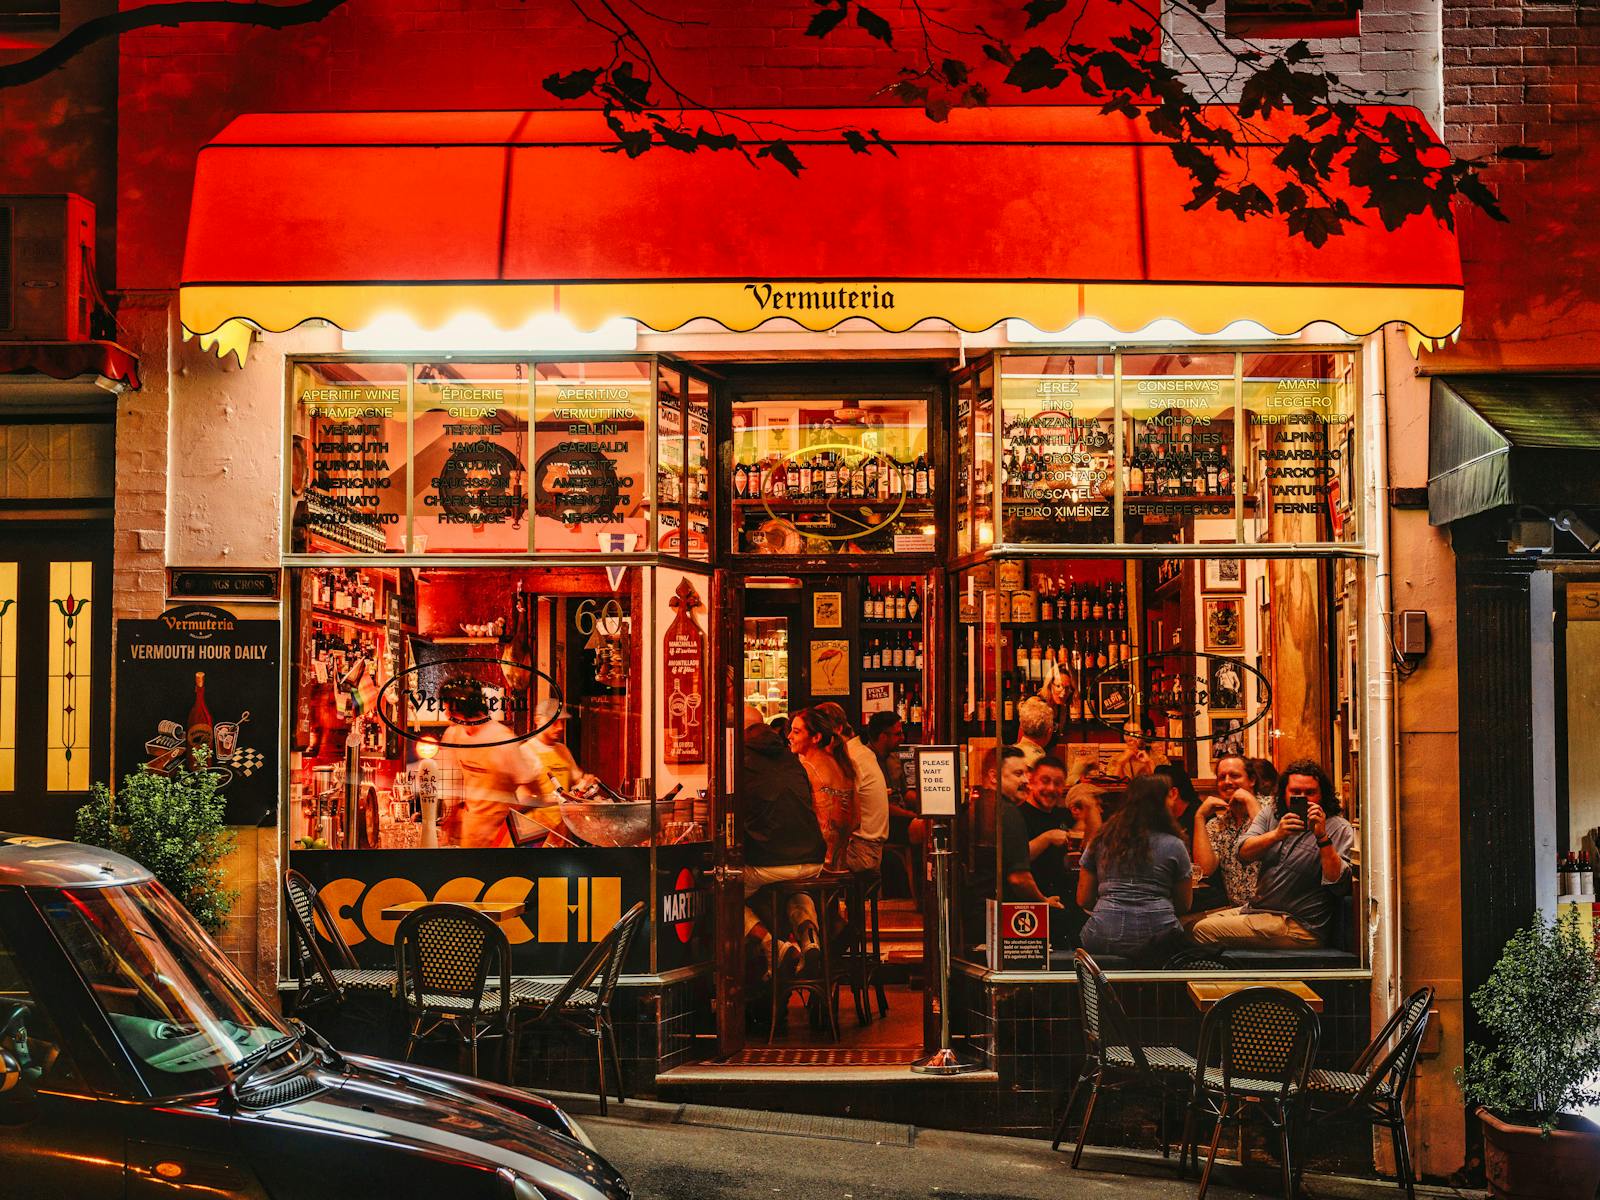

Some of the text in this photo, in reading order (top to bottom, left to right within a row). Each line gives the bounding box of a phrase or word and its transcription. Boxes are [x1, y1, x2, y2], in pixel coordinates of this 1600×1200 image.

[744, 284, 894, 310] Vermuteria
[1037, 382, 1078, 393] JEREZ
[1137, 381, 1219, 391] CONSERVAS
[1278, 380, 1319, 390] AMARI
[302, 390, 400, 400] APERITIF WINE
[442, 386, 503, 400] ÉPICERIE
[558, 389, 629, 400] APERITIVO
[1042, 400, 1074, 410] FINO
[1150, 399, 1208, 409] SARDINA
[1266, 397, 1332, 407] LEGGERO
[309, 407, 393, 418] CHAMPAGNE
[448, 408, 497, 418] GILDAS
[554, 408, 635, 419] VERMUTTINO
[1016, 418, 1100, 428] MANZANILLA
[1146, 416, 1211, 426] ANCHOAS
[1250, 415, 1348, 425] MEDITERRANEO
[322, 425, 380, 436] VERMUT
[443, 425, 501, 435] TERRINE
[569, 425, 618, 435] BELLINI
[1010, 436, 1104, 446] AMONTILLADO
[1138, 434, 1220, 444] MEJILLONES
[1275, 432, 1323, 442] ALPINO
[312, 442, 388, 453] VERMOUTH
[448, 440, 496, 453] JAMÓN
[558, 442, 628, 453] GARIBALDI
[1026, 453, 1091, 464] OLOROSO
[1138, 452, 1219, 462] CALAMARES
[1259, 450, 1341, 460] RABARBARO
[313, 460, 389, 471] QUINQUINA
[1045, 471, 1107, 481] CORTADO
[1265, 468, 1335, 478] CARCIOFO
[311, 478, 391, 489] AMERICANO
[432, 478, 510, 489] SAUCISSON
[552, 477, 633, 488] AMERICANO
[1024, 489, 1094, 499] MOSCATEL
[1271, 485, 1330, 496] TARTUFO
[424, 496, 520, 506] CHARCUTERIE
[556, 495, 611, 506] FRENCH
[1008, 505, 1109, 517] PEDRO XIMÉNEZ
[438, 513, 505, 524] FROMAGE
[562, 513, 624, 524] NEGRONI
[234, 579, 265, 590] CROSS
[576, 599, 622, 634] 60
[162, 616, 234, 631] Vermuteria
[811, 641, 849, 652] CARPANO
[130, 645, 267, 660] VERMOUTH HOUR DAILY
[664, 892, 703, 922] MARTI
